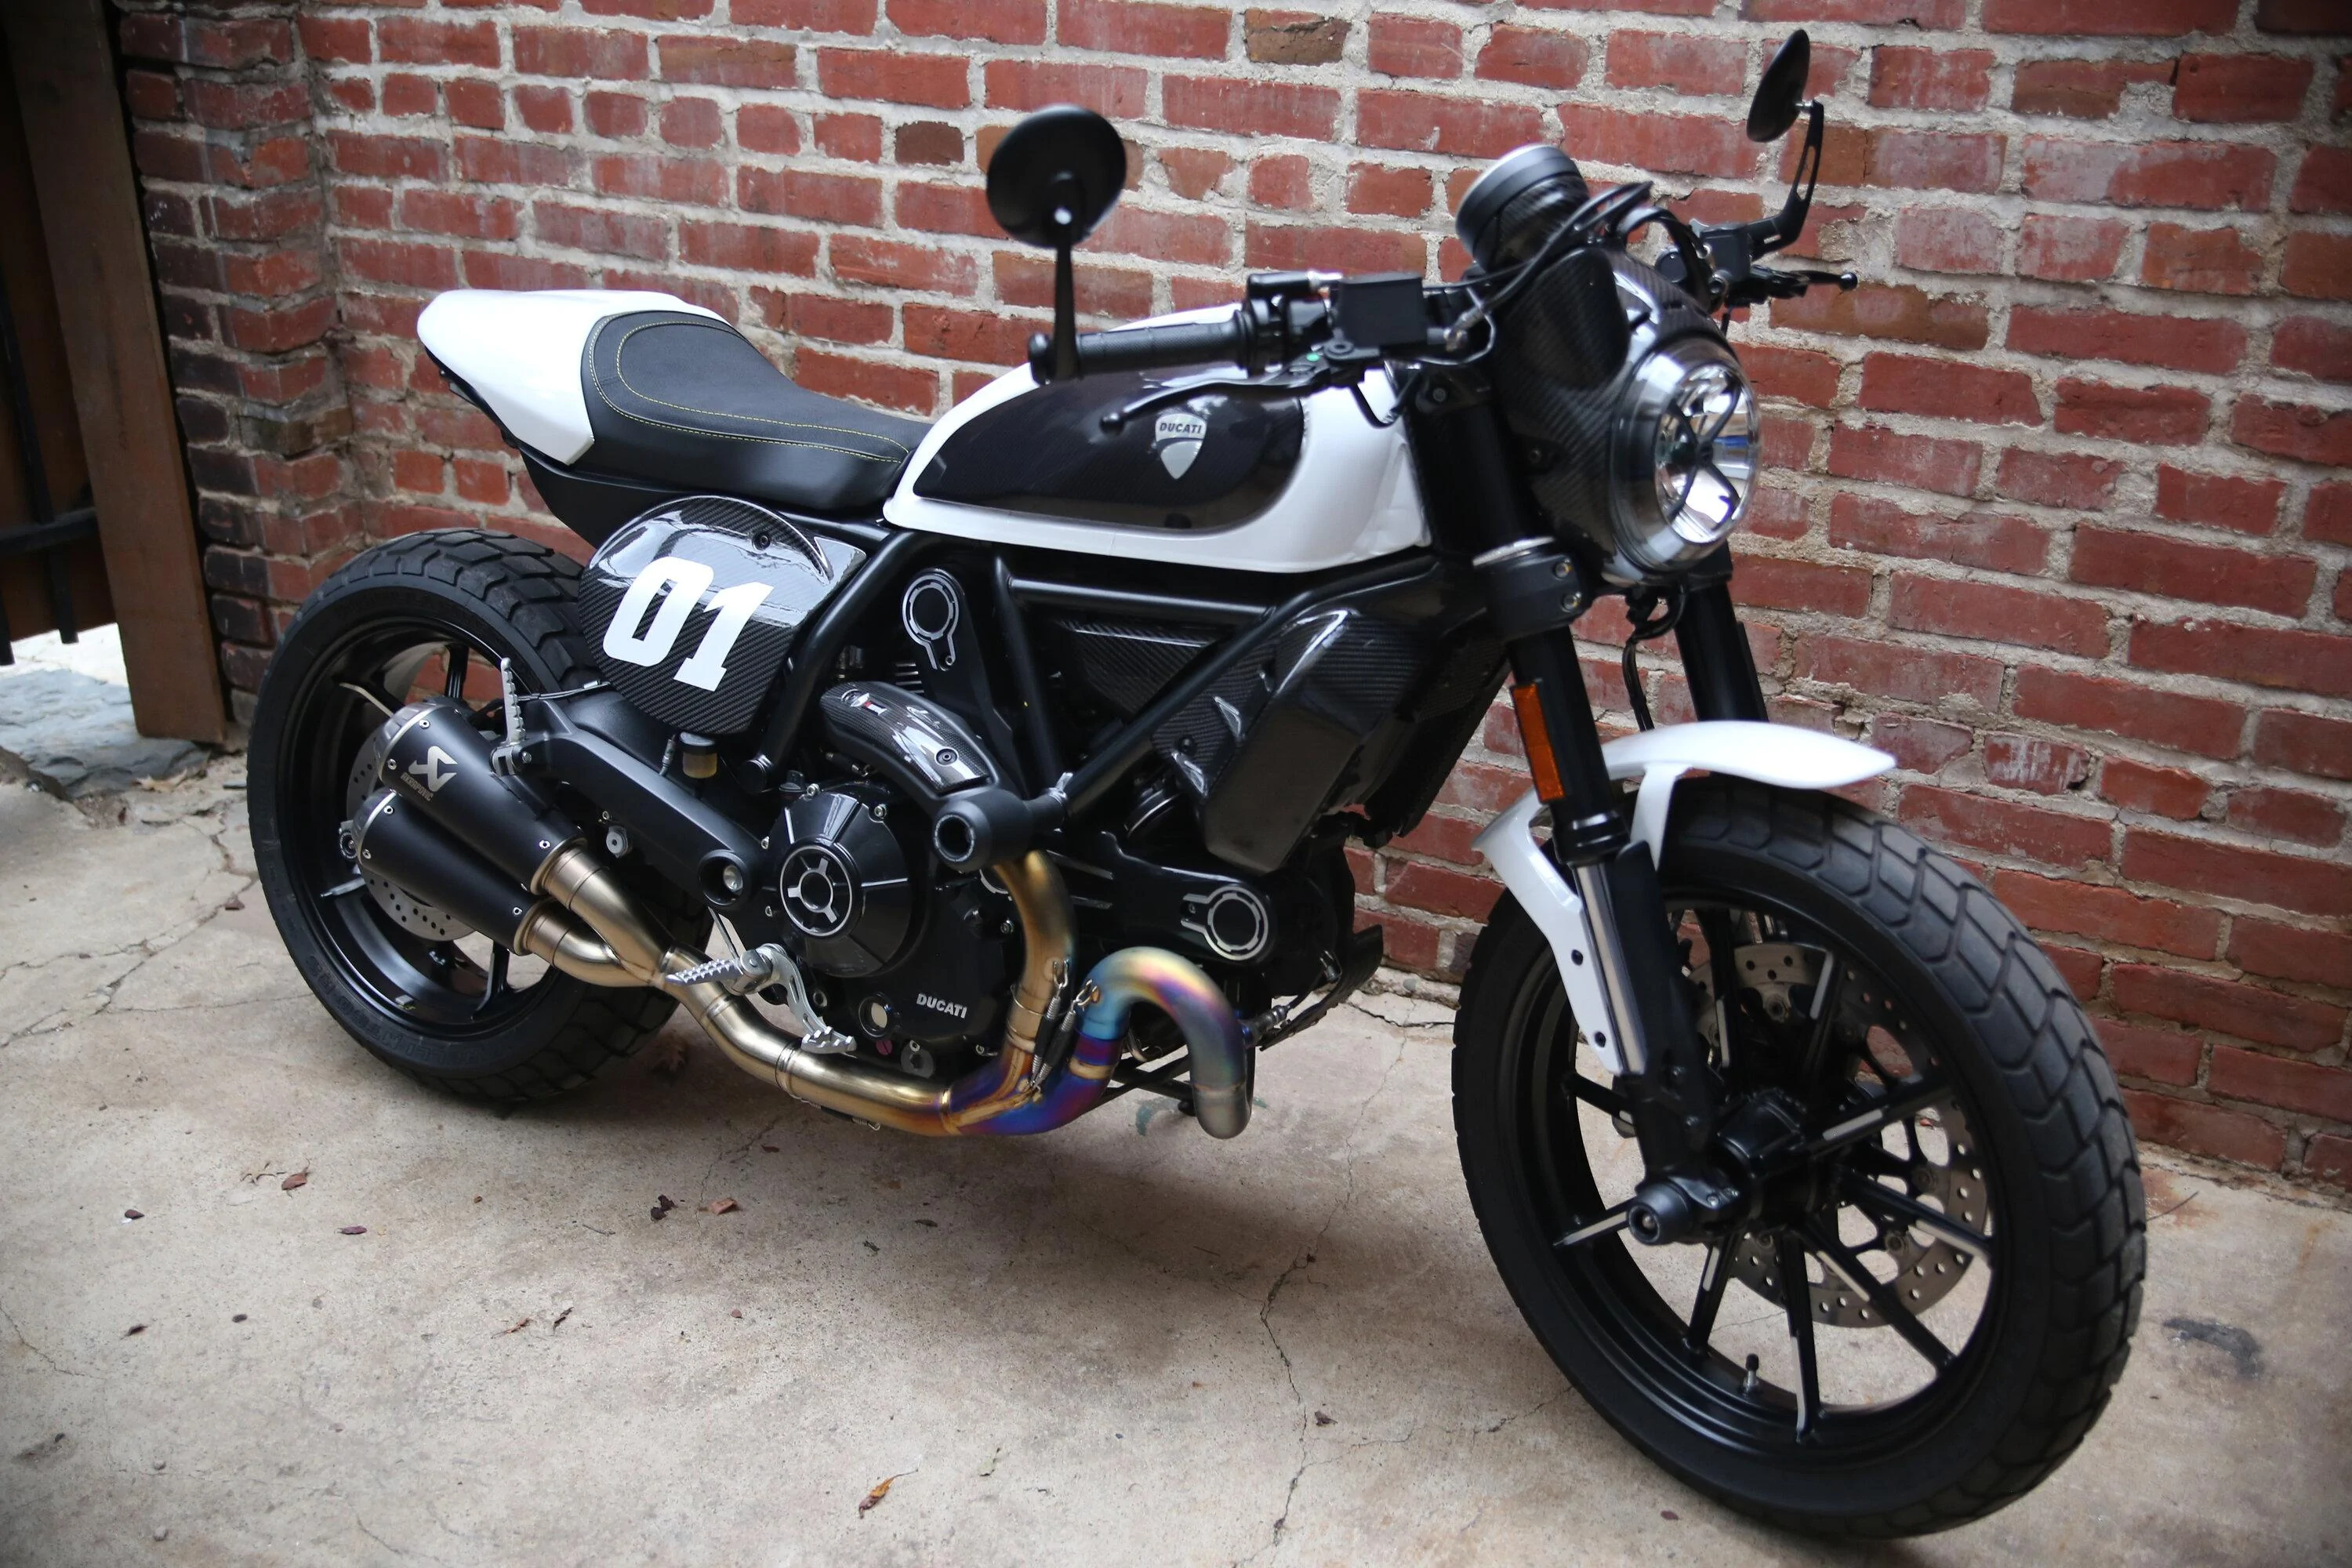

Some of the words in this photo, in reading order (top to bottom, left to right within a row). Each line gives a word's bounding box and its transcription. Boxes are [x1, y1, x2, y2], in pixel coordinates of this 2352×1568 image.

[1160, 422, 1202, 434] DUCATI
[602, 555, 775, 692] 01
[916, 993, 968, 1019] DUCATI
